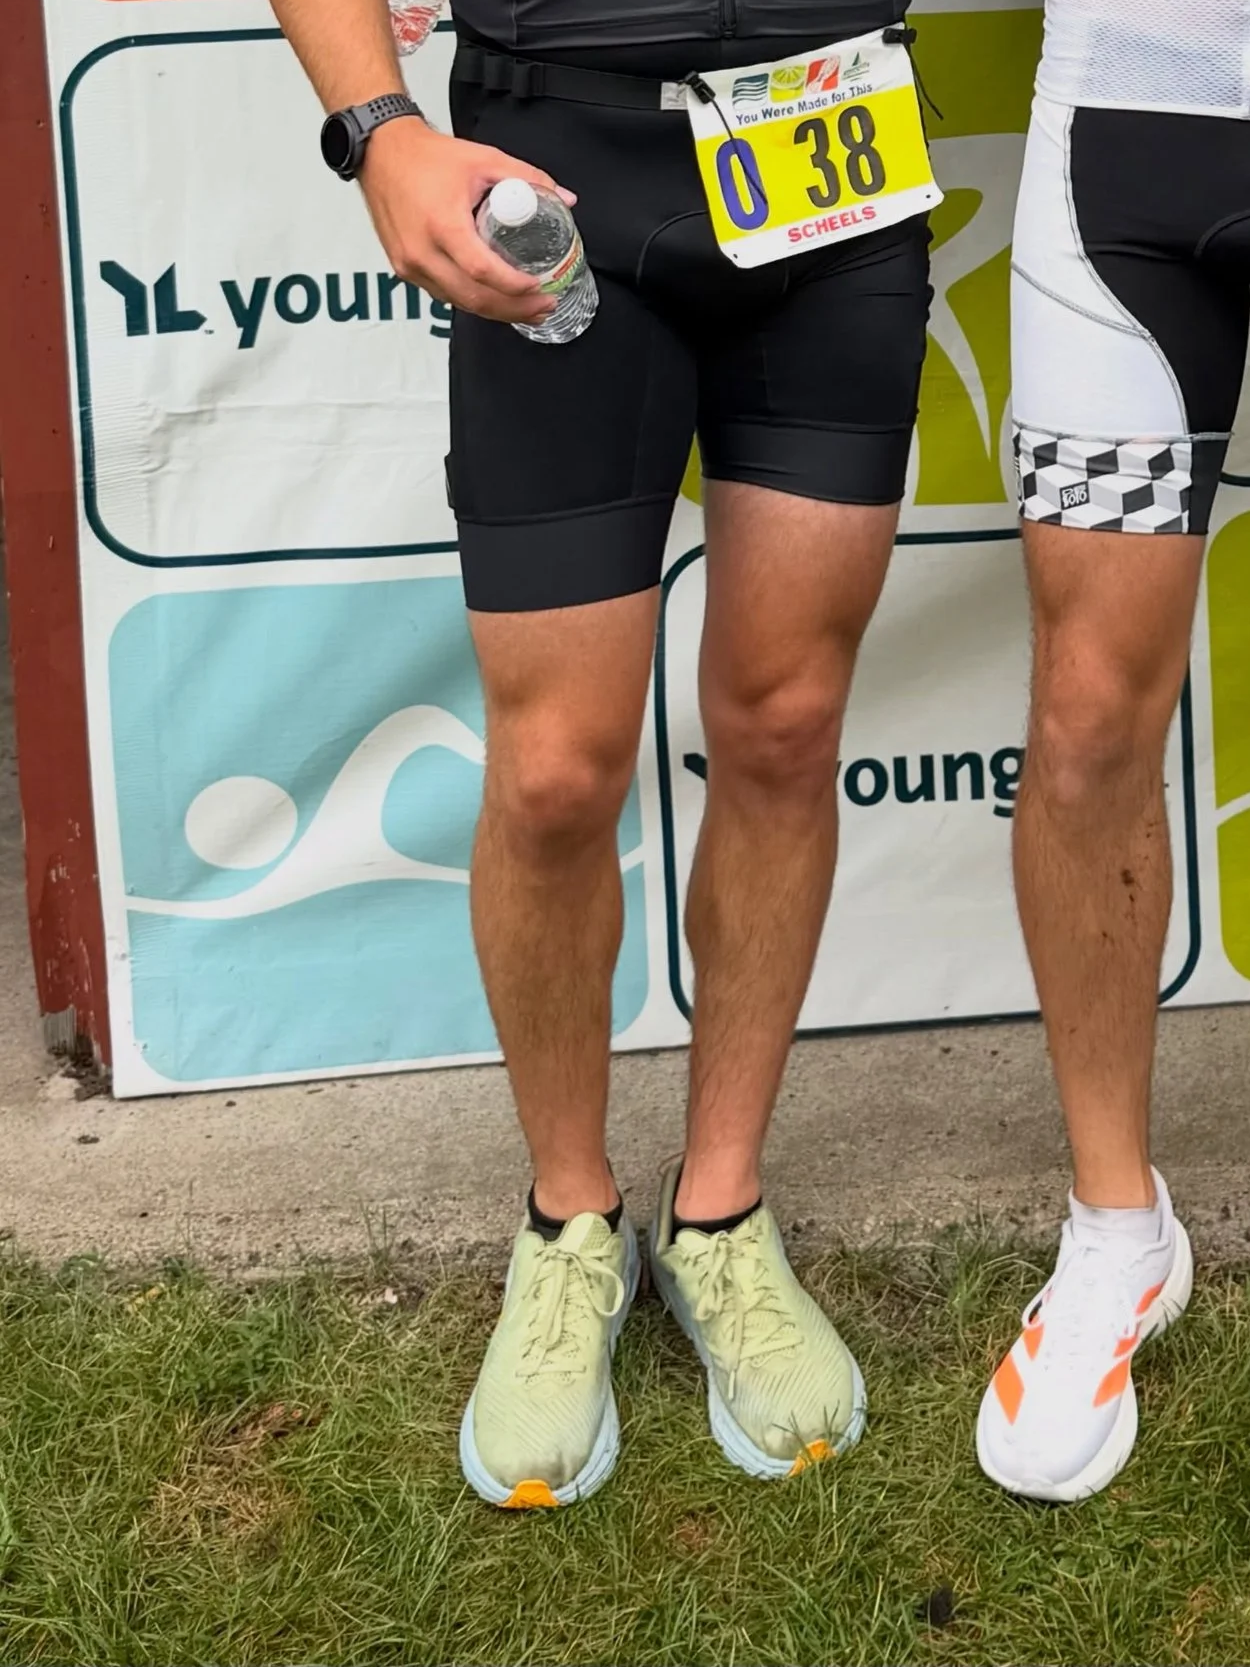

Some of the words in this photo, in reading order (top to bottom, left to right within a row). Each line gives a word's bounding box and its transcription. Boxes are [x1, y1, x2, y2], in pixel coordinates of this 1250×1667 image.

[736, 109, 758, 126] You
[761, 105, 794, 120] Were
[798, 97, 828, 113] Made
[831, 91, 846, 104] for
[849, 83, 873, 100] This
[793, 105, 886, 208] 38
[787, 206, 877, 242] SCHEELS
